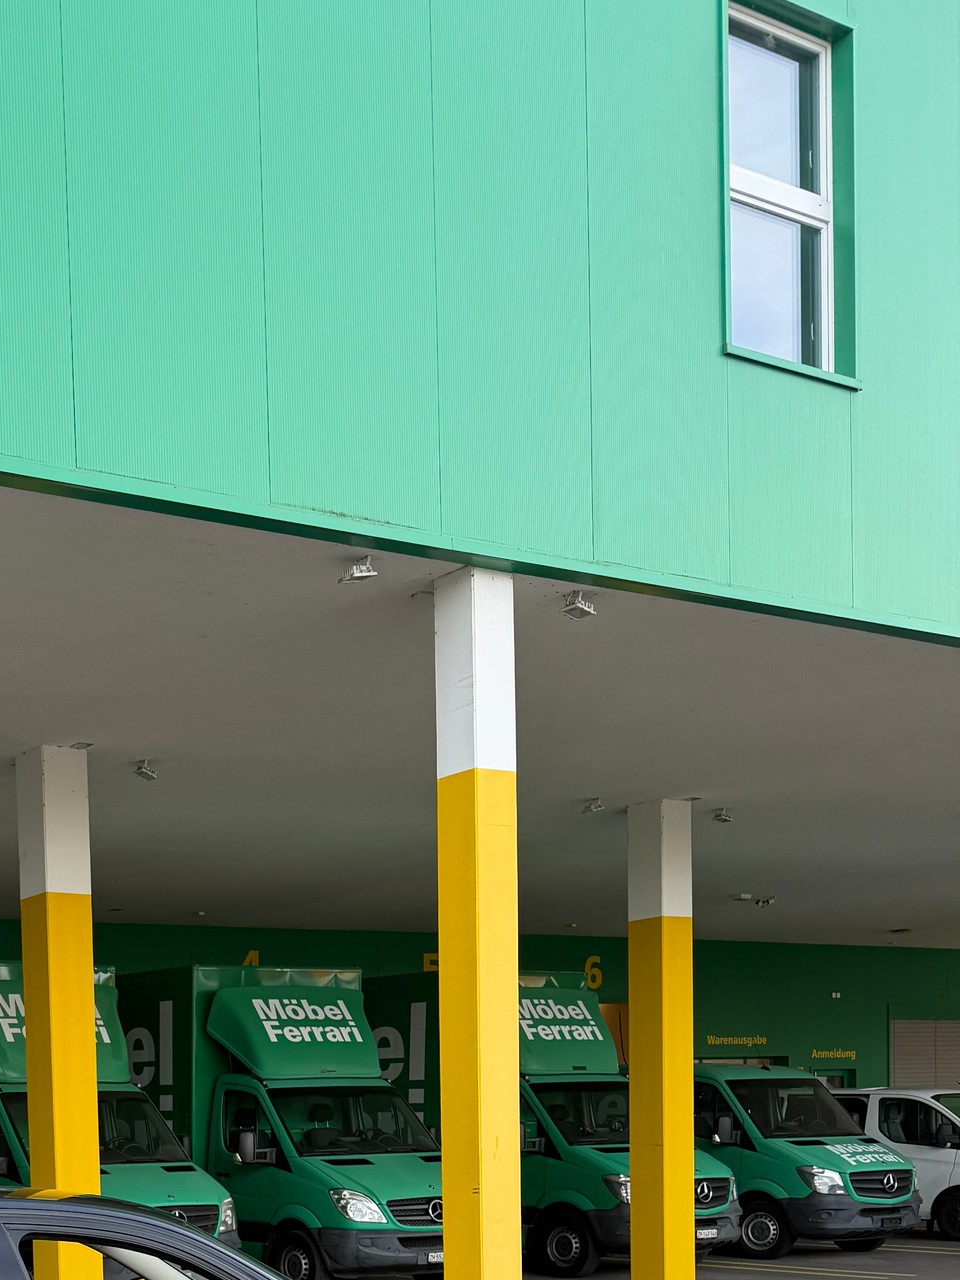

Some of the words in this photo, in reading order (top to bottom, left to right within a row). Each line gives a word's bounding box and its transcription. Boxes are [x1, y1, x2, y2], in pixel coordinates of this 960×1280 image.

[584, 955, 603, 989] 6
[251, 999, 353, 1021] Möbel
[262, 1020, 364, 1043] Ferrari
[520, 1020, 605, 1041] Ferrari
[707, 1034, 768, 1047] Warenausgabe
[811, 1048, 857, 1060] Anmeldung
[824, 1143, 893, 1155] Möbel
[840, 1153, 905, 1166] Ferrari
